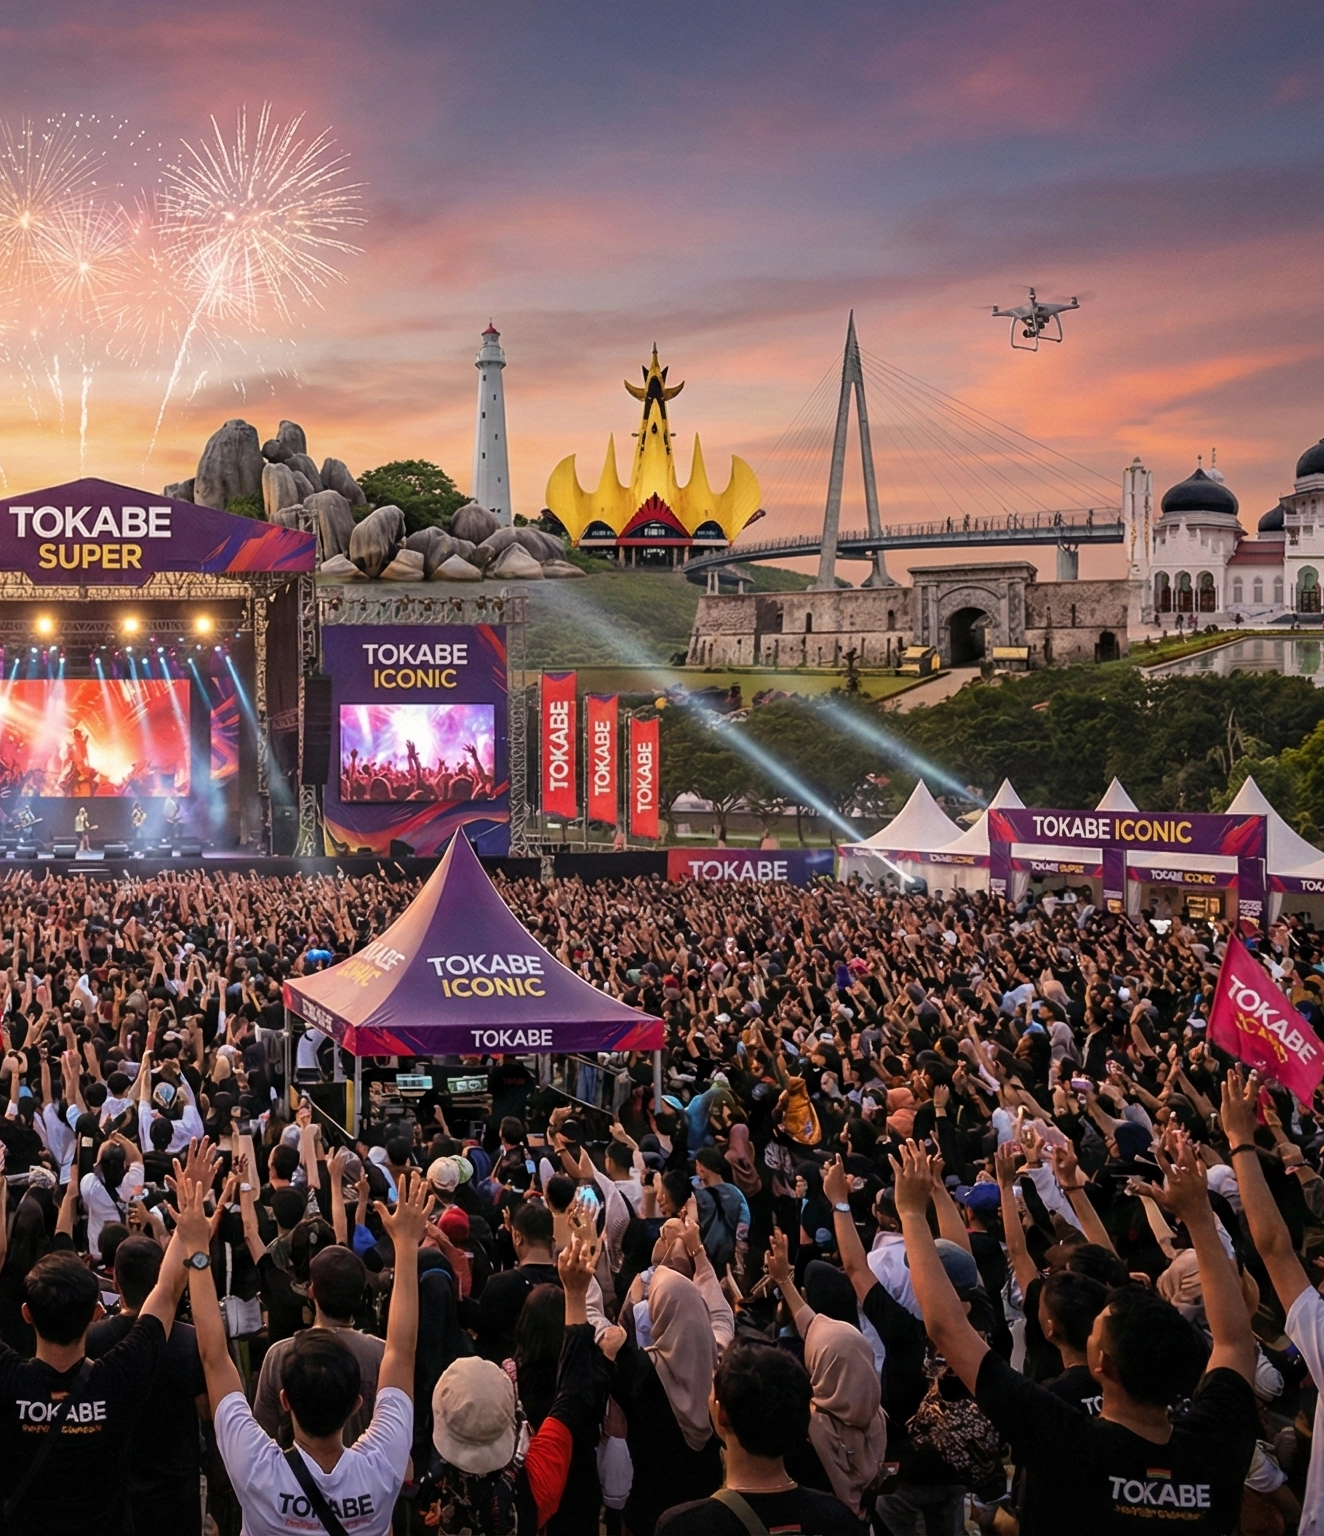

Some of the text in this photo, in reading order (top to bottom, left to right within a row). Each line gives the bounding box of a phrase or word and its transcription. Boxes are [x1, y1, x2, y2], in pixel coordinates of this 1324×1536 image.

[9, 505, 172, 539] TOKABE
[38, 543, 142, 570] SUPER
[362, 643, 468, 665] TOKABE
[373, 668, 458, 689] ICONIC
[549, 700, 569, 791] TOKABE
[593, 720, 611, 796] TOKABE
[636, 741, 653, 814] TOKABE
[1032, 815, 1193, 844] TOKABE ICONIC
[688, 860, 788, 882] TOKABE
[1300, 880, 1324, 892] TOK
[426, 953, 545, 977] TOKABE
[441, 977, 546, 998] ICONIC
[1228, 974, 1317, 1065] TOKABE
[471, 1029, 553, 1048] TOKABE
[15, 1399, 107, 1422] TOKABE
[1108, 1475, 1211, 1508] TOKABE
[279, 1492, 375, 1519] TOABE
